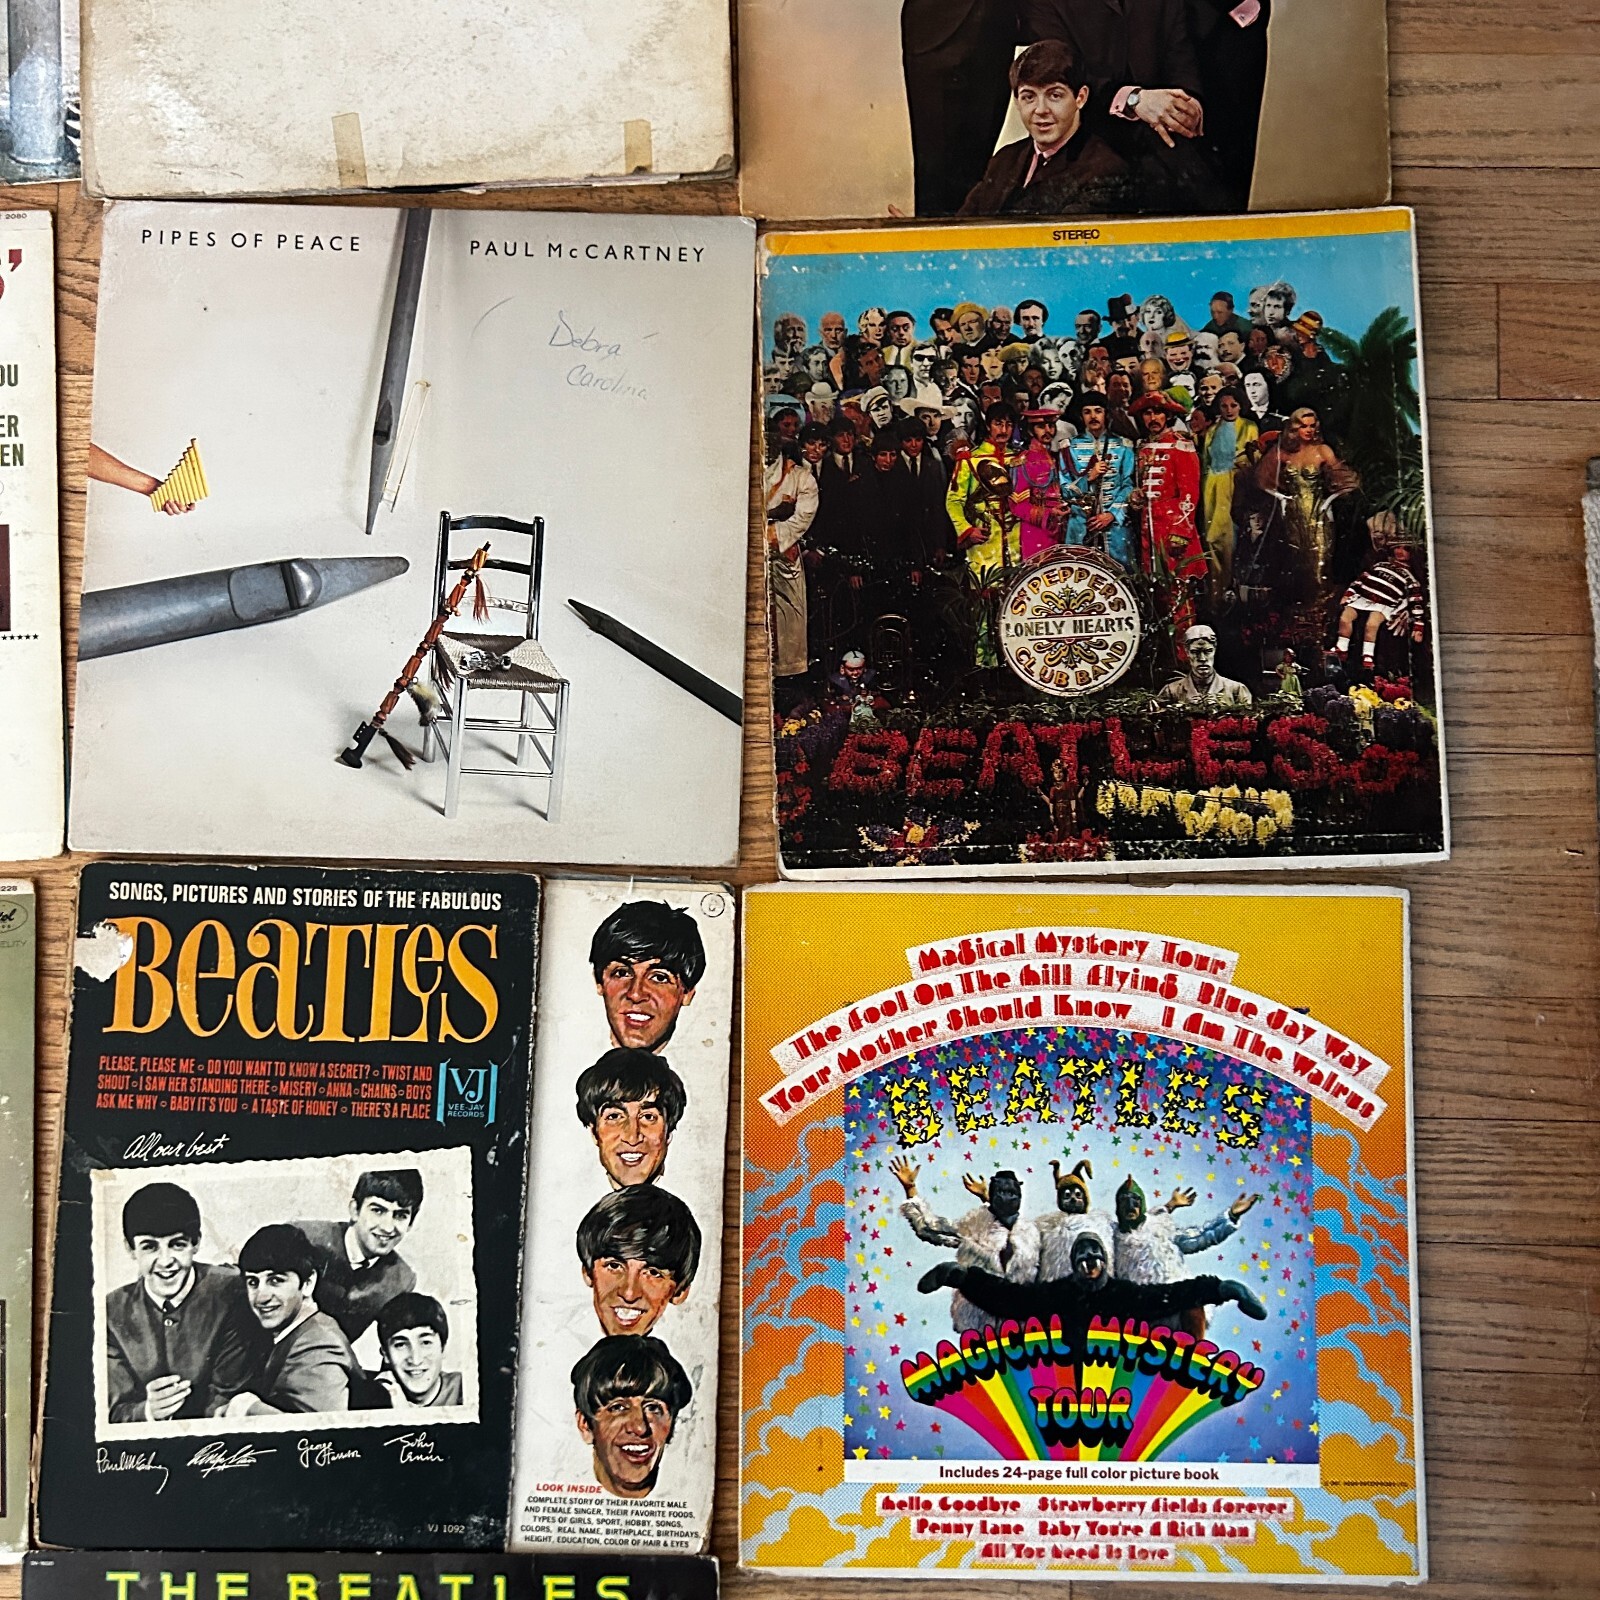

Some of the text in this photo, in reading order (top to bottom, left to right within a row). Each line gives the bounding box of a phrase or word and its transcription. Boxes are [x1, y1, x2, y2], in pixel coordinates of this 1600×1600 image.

[141, 229, 361, 252] PIPES OF PEACE
[1053, 229, 1100, 240] STEREO
[469, 240, 705, 263] PAUL McCARTNEY
[1005, 616, 1135, 638] LONELY HEARTS
[1015, 640, 1128, 688] CLUB BAND
[829, 715, 1338, 801] BEATLES
[109, 881, 501, 911] SONGS, PICTURES AND STORIES OF THE FABULOUS
[918, 931, 1227, 976] Magical Mystery Tour
[788, 1025, 842, 1060] The
[914, 983, 954, 1006] On
[955, 969, 1011, 995] The
[1196, 981, 1259, 1020] Blue
[1324, 1033, 1373, 1077] Way
[767, 994, 1376, 1119] Your Mother Should Know I Am The Walrus
[140, 1056, 176, 1073] PLEASE
[178, 1058, 196, 1074] ME
[207, 1059, 222, 1075] DO
[223, 1059, 242, 1076] YOU
[245, 1060, 272, 1077] WANT
[274, 1061, 286, 1077] TO
[289, 1062, 318, 1078] KNOW
[319, 1063, 326, 1078] A
[327, 1063, 371, 1080] SECRET?
[382, 1064, 411, 1081] TWIST
[412, 1066, 433, 1082] AND
[97, 1074, 432, 1100] SHOUT SAW HER STANDING THERE MISERY ANNA CHAINS BOYS
[448, 1067, 489, 1104] VJ
[96, 1093, 430, 1119] ASK ME WHY BABY IT'S YOU A TASTE OF HONEY THERE'S PLACE
[447, 1103, 485, 1111] VEE-JAY
[882, 1055, 1270, 1149] BEATLES
[447, 1110, 485, 1118] RECORDS
[122, 1131, 231, 1161] All our best
[900, 1313, 1266, 1408] MAGICAL MYSTERY
[1029, 1386, 1135, 1448] TOUR
[939, 1465, 1220, 1482] Includes 24-page full color picture book
[536, 1483, 604, 1494] LOOK INSIDE
[524, 1505, 541, 1514] AND
[542, 1506, 572, 1515] FEMALE
[606, 1508, 629, 1517] THEIR
[630, 1509, 666, 1518] FAVORITE
[527, 1495, 688, 1509] COMPLETE STORY OF THEIR FAVORITE MALE
[938, 1495, 1021, 1516] Goodbye
[1037, 1496, 1148, 1517] Strawberry
[427, 1523, 466, 1534] VJ 1092
[533, 1515, 556, 1523] TYPES
[557, 1516, 568, 1525] OF
[557, 1526, 577, 1534] REAL
[916, 1518, 974, 1538] Penny
[979, 1520, 1025, 1536] Lane
[1038, 1520, 1081, 1541] Baby
[1085, 1520, 1144, 1537] You're
[1167, 1520, 1206, 1538] Rich
[1211, 1521, 1250, 1538] Man
[603, 1537, 630, 1546] COLOR
[631, 1538, 641, 1546] OF
[642, 1539, 661, 1547] HAIR
[670, 1540, 690, 1548] EYES
[981, 1543, 1007, 1559] All
[1128, 1544, 1170, 1561] Love
[106, 1571, 250, 1600] THE
